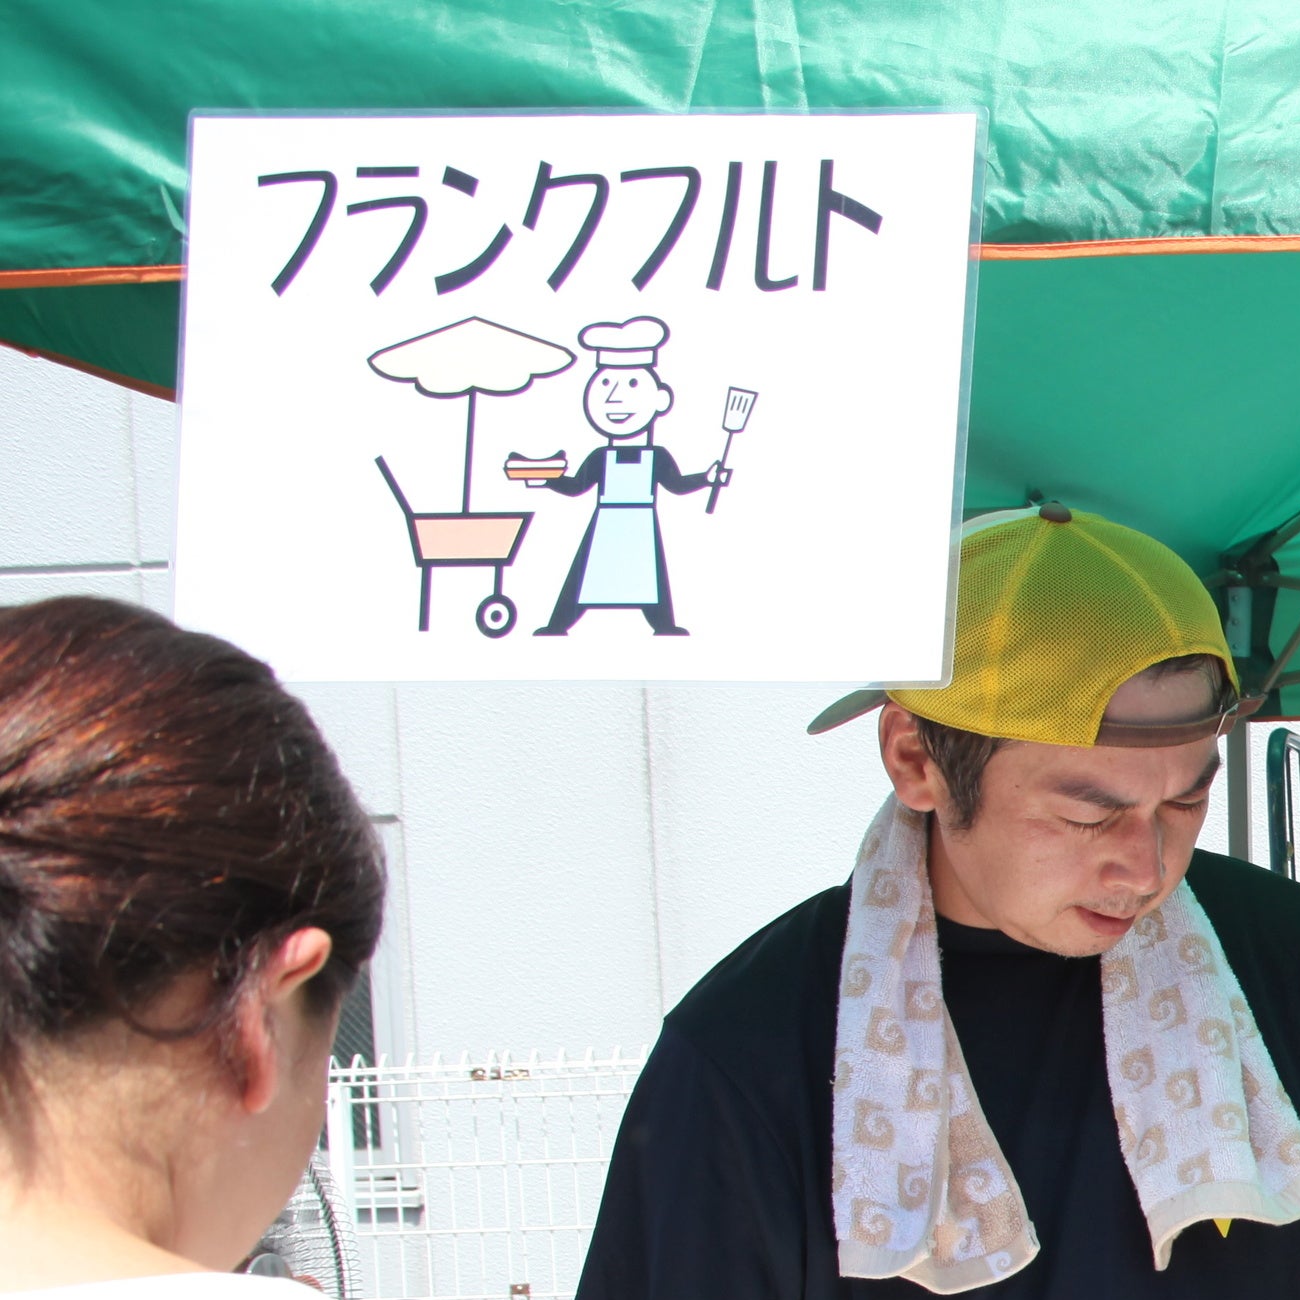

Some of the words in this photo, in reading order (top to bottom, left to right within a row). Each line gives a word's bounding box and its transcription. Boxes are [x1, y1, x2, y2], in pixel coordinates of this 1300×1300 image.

[257, 158, 883, 297] フランクフルト
